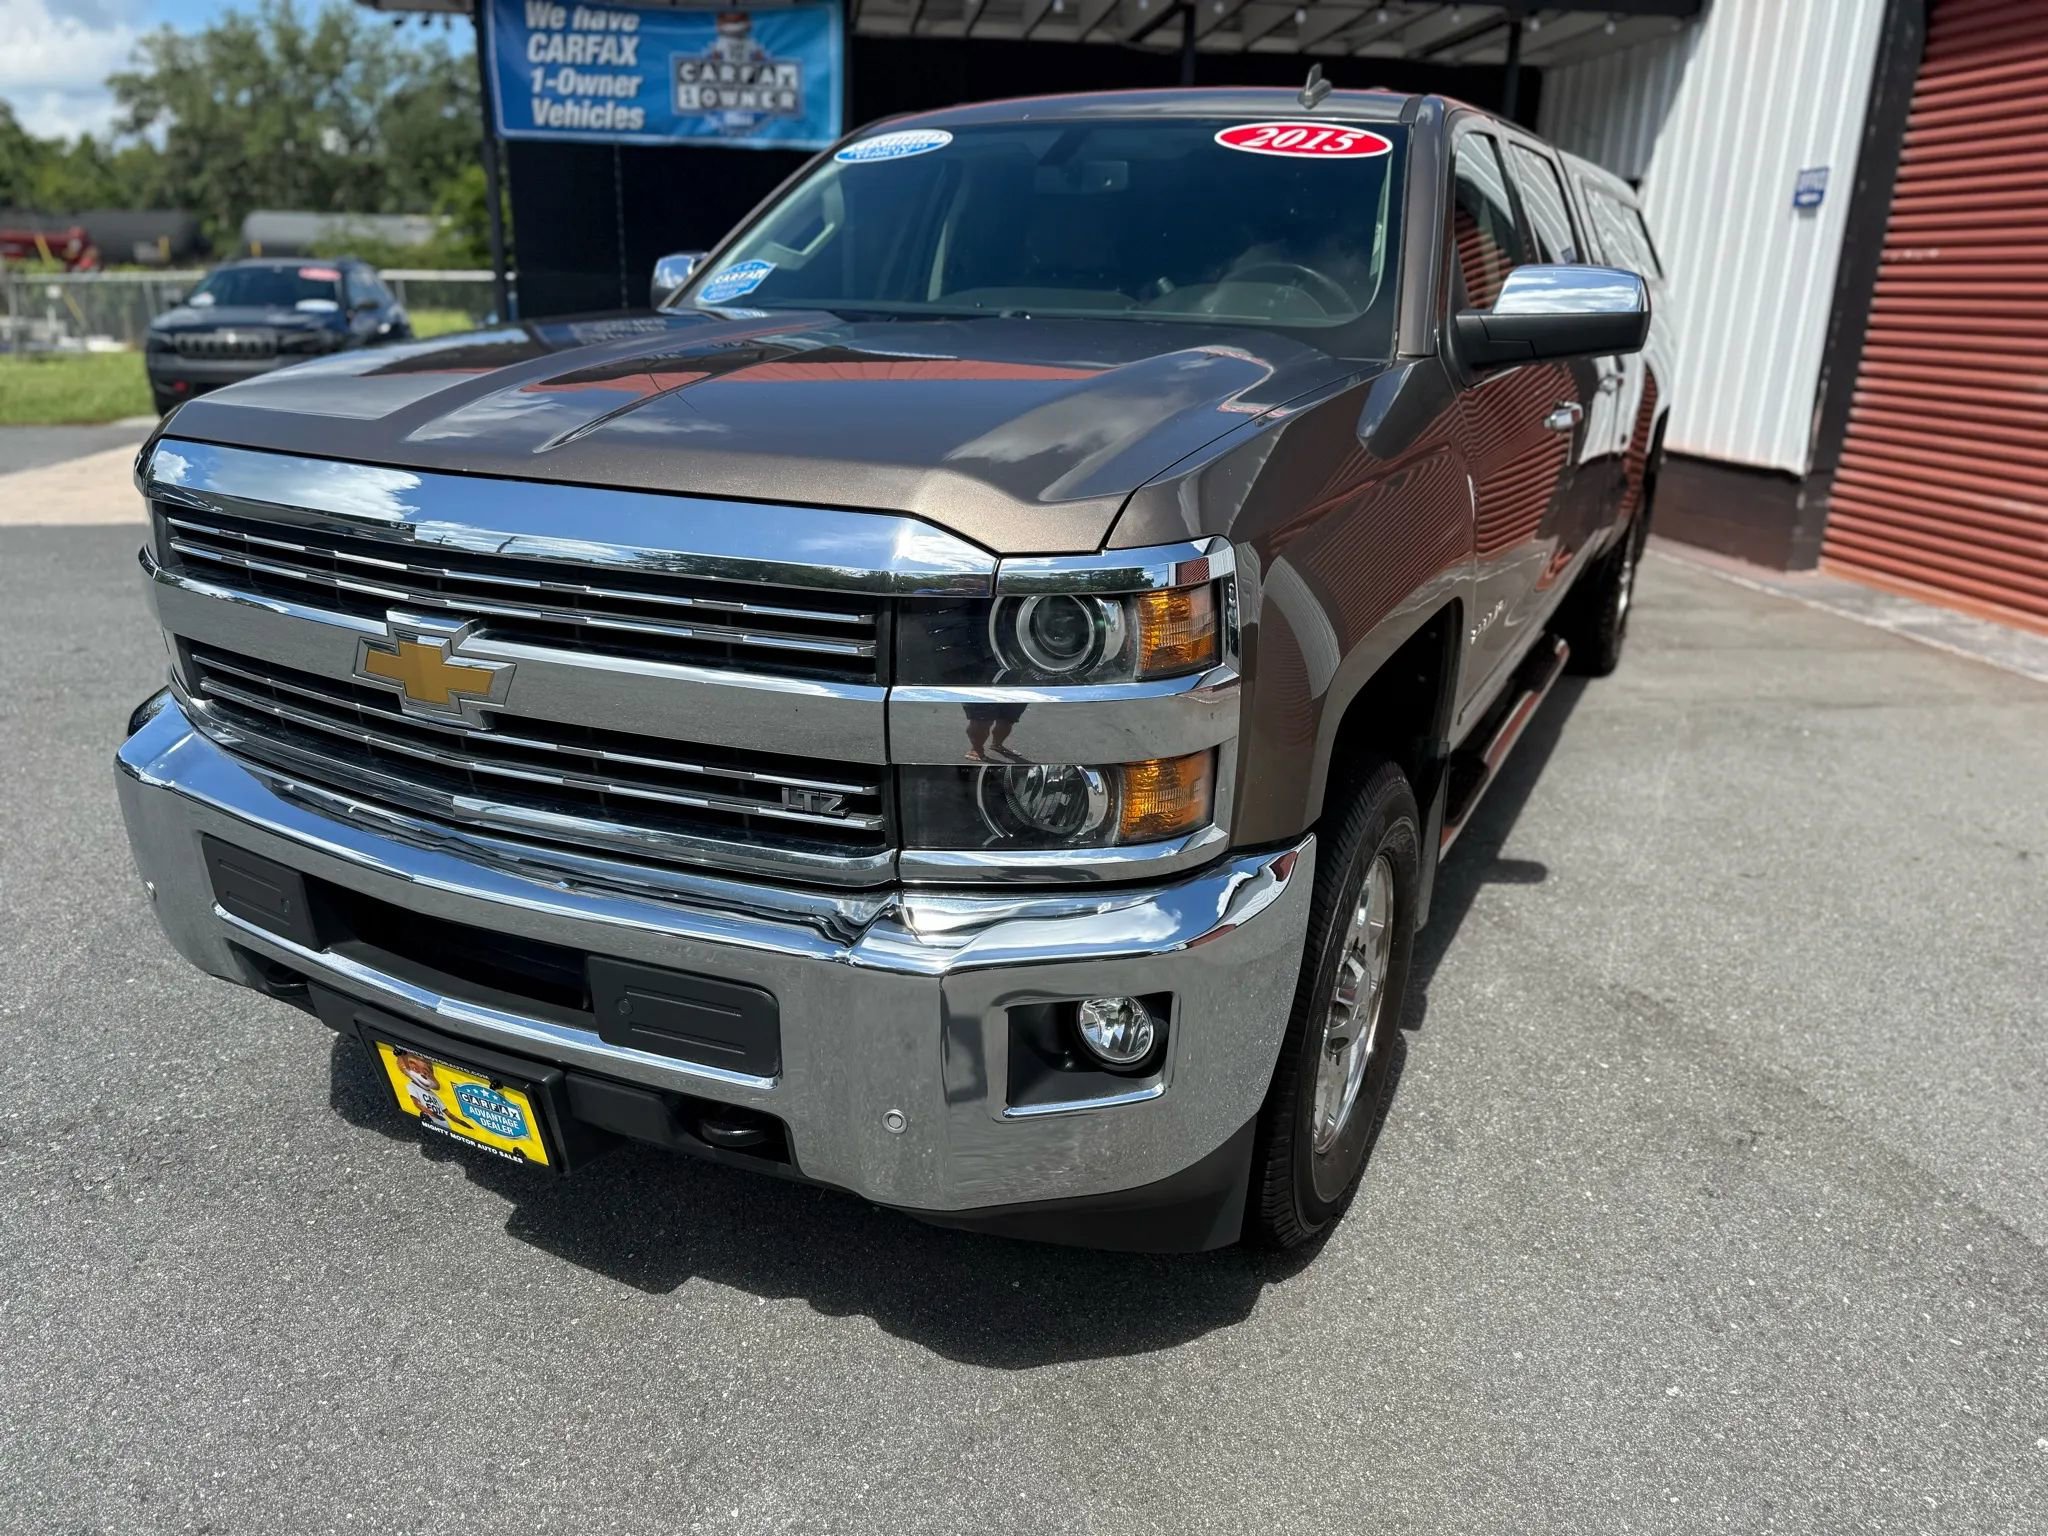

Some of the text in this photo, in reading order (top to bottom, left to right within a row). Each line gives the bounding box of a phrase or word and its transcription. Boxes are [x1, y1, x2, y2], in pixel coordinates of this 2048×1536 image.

[525, 0, 640, 32] We have
[527, 33, 639, 65] CARFAX
[531, 67, 642, 97] 1-Owner
[532, 98, 644, 129] Vehicles
[702, 90, 796, 108] OWNER
[1240, 127, 1366, 152] 2015
[781, 786, 847, 816] LTZ
[461, 1093, 520, 1120] CARFAX
[469, 1106, 520, 1129] ADVANTAGE
[480, 1117, 514, 1136] DEALER
[421, 1121, 523, 1164] MIGHTY MOTOR AUTO SALES
